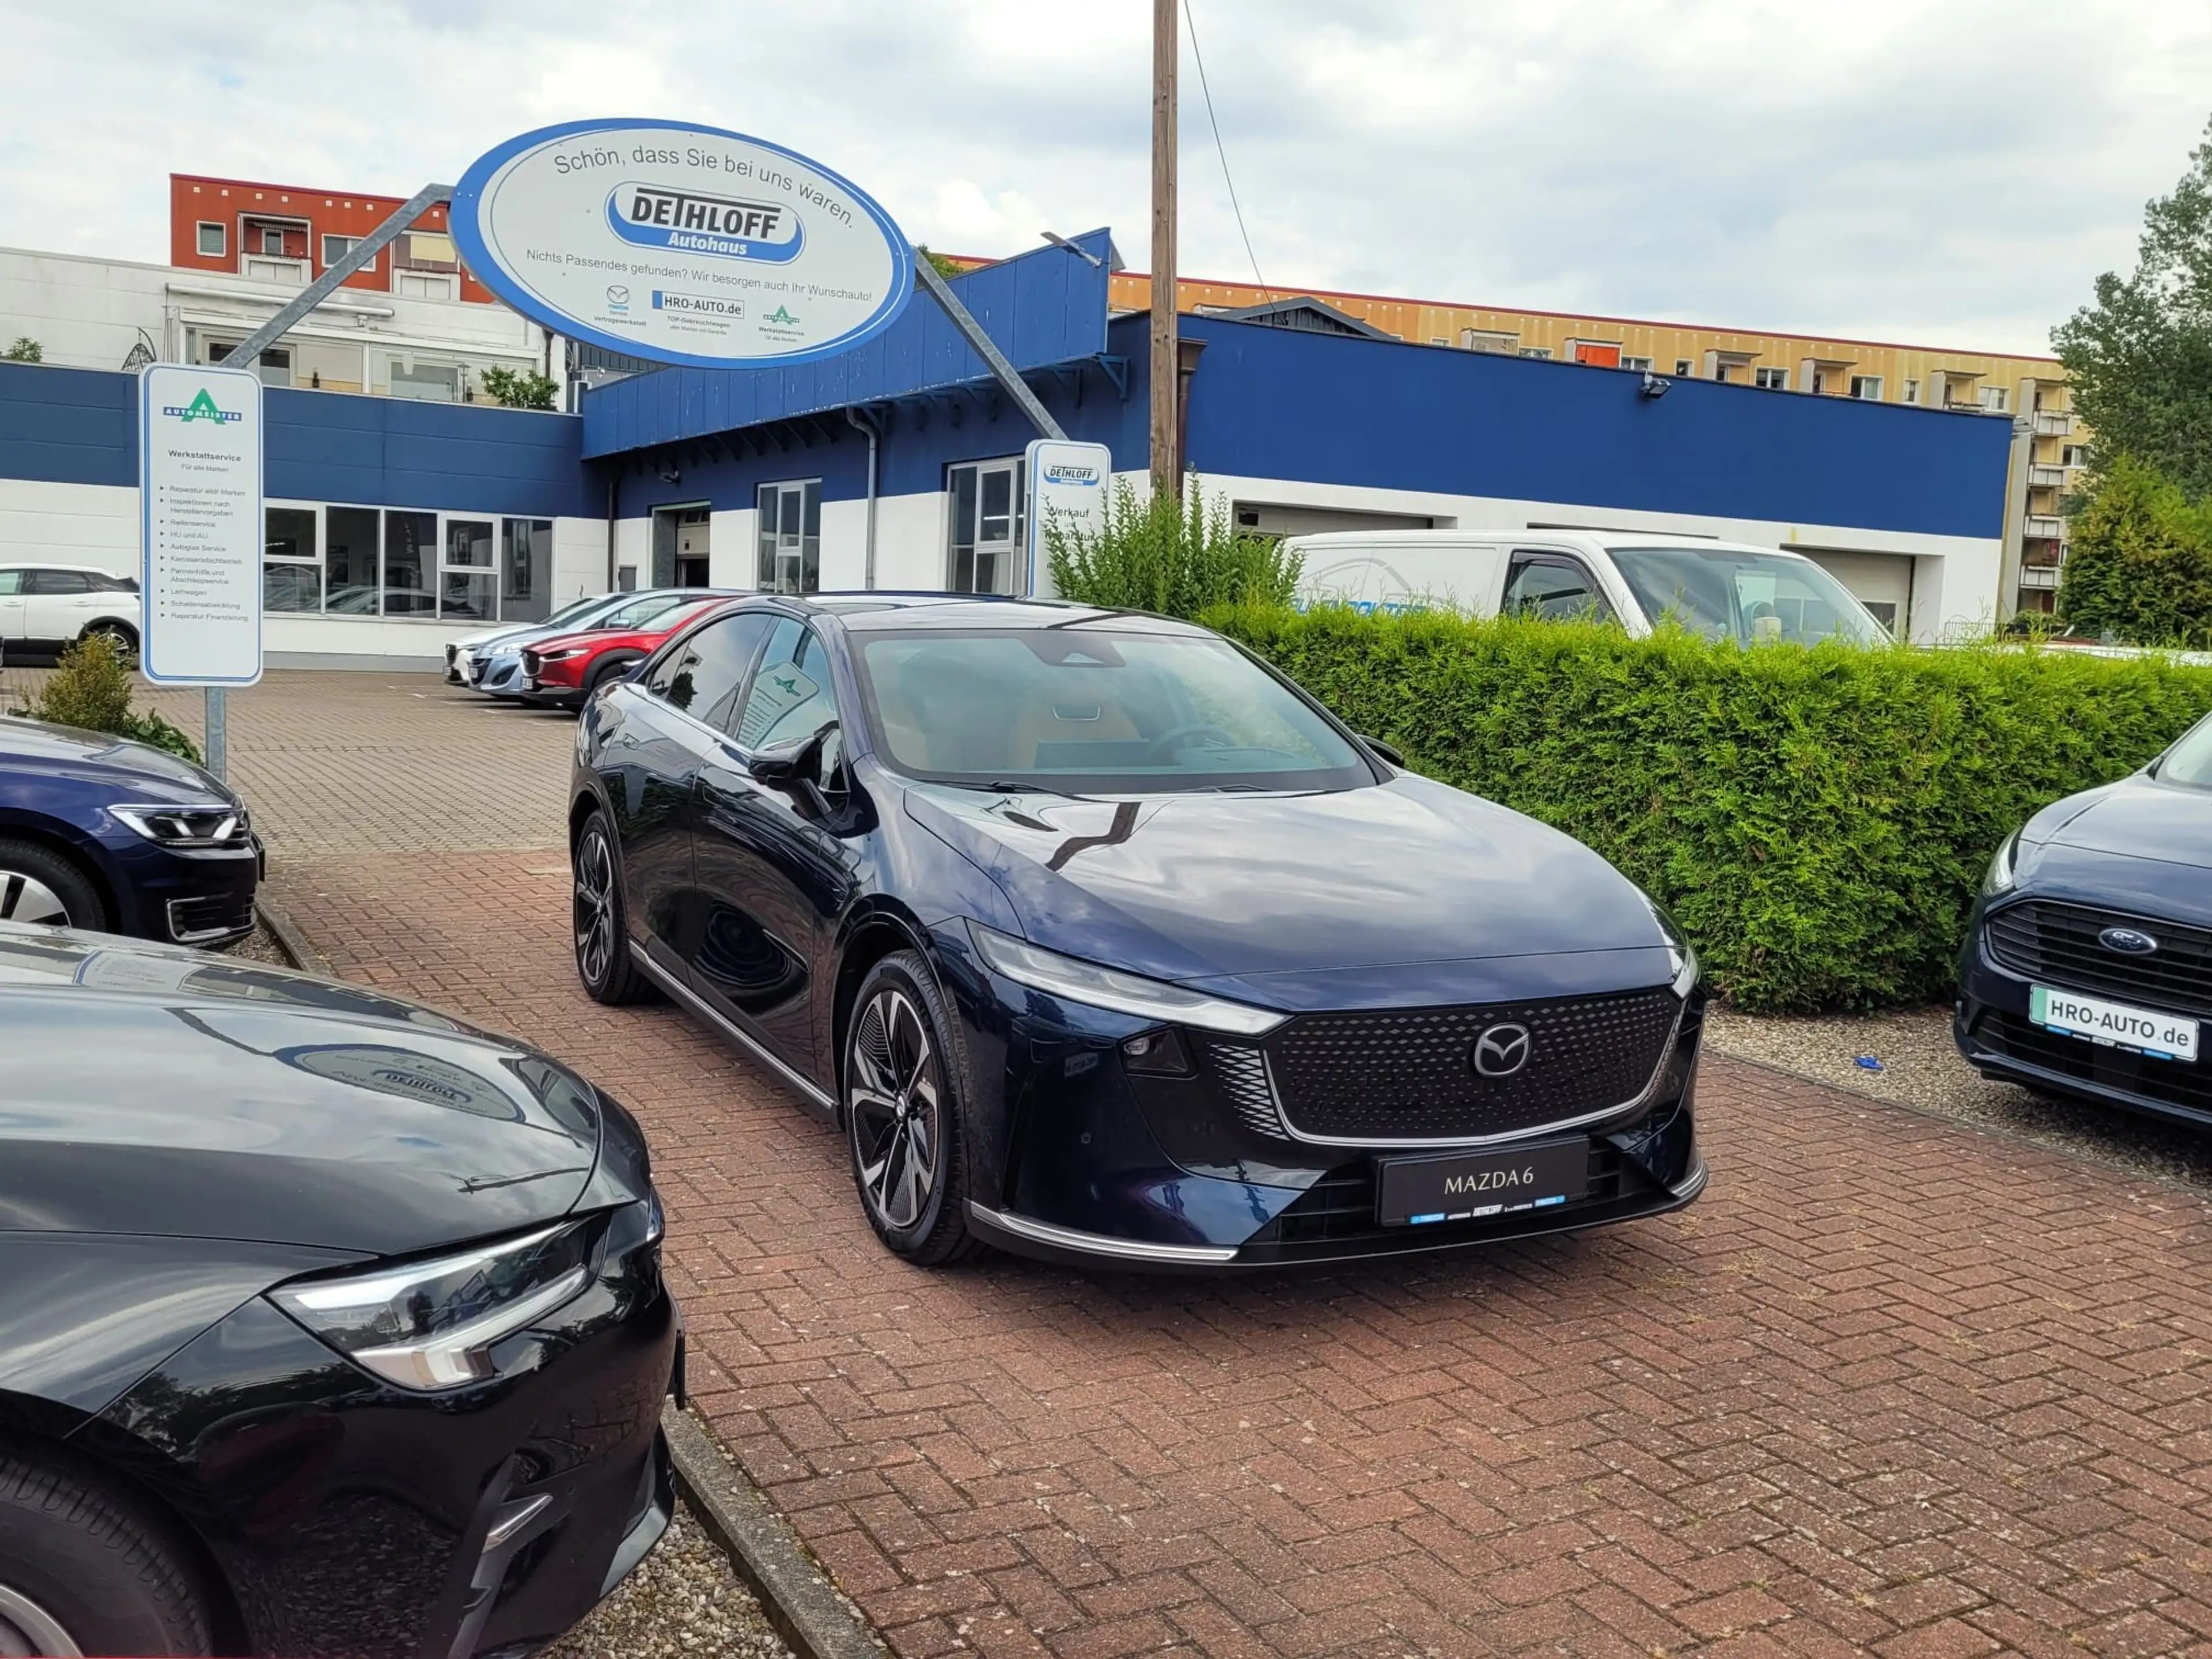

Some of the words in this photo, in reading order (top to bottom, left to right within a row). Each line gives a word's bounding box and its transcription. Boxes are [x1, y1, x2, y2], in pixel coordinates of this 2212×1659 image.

[554, 147, 626, 174] Schön,
[632, 145, 679, 164] dass
[687, 148, 717, 169] Sie
[725, 154, 753, 177] bei
[759, 168, 793, 191] uns
[800, 183, 853, 229] waren.
[631, 188, 782, 238] DETHLOFF
[668, 232, 747, 255] Autohaus
[527, 249, 562, 263] Nichts
[566, 254, 627, 271] Passendes
[631, 263, 687, 279] gefunden?
[691, 270, 710, 282] Wir
[712, 272, 760, 289] besorgen
[763, 281, 789, 291] auch
[791, 283, 806, 293] Ihr
[808, 284, 872, 302] Wunschauto!
[664, 296, 742, 315] HRO-AUTO.de
[164, 407, 241, 421] AUTOMEISTER
[168, 449, 241, 461] Werkstattservice
[1050, 465, 1094, 479] DETHLOFF
[2051, 999, 2189, 1047] HRO-AUTO.de
